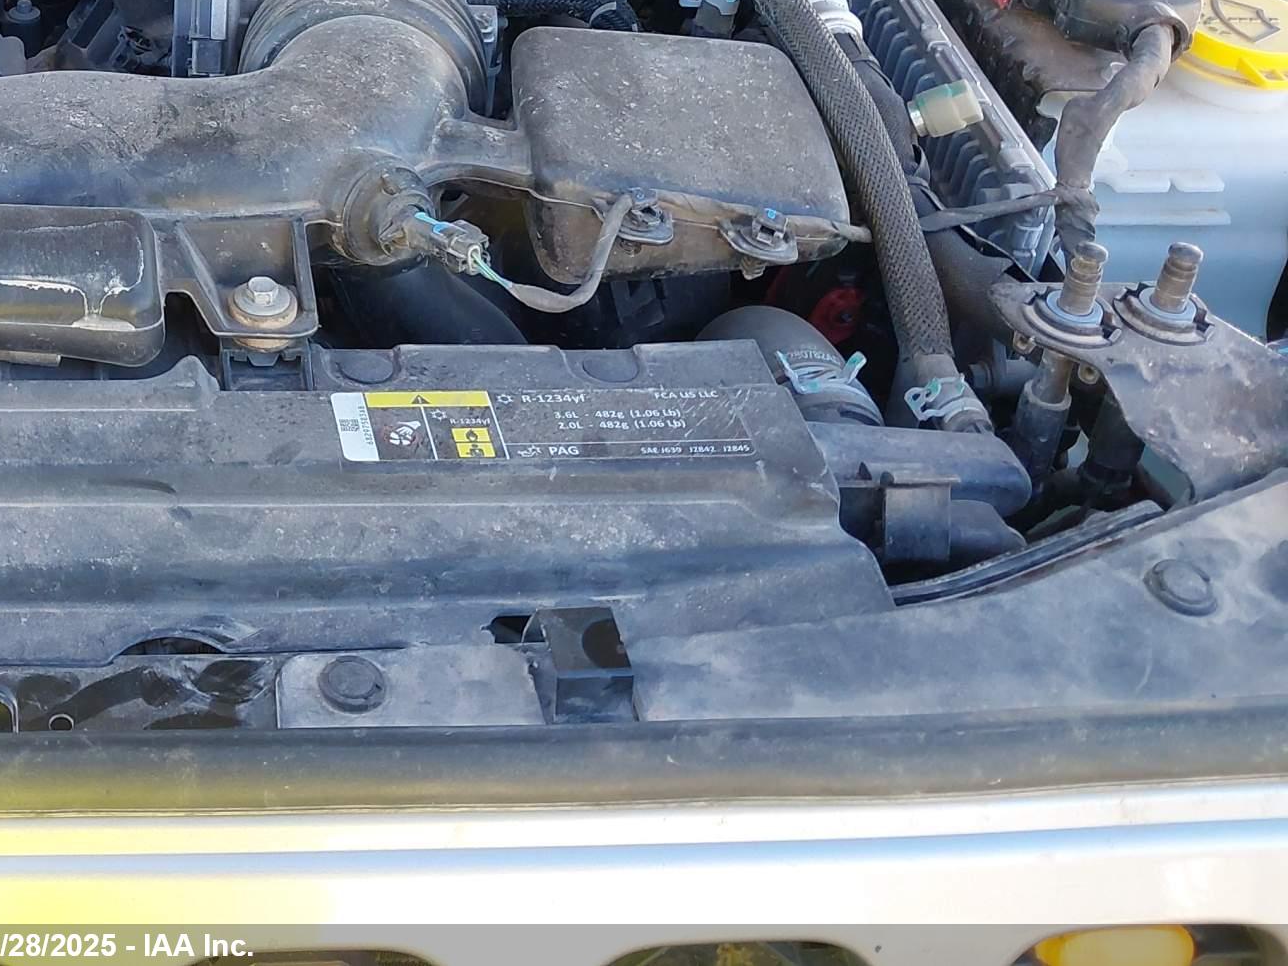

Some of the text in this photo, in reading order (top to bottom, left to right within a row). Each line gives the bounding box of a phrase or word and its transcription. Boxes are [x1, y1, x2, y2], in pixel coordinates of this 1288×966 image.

[521, 393, 587, 404] R-1234yf
[654, 390, 719, 399] FCA US LLC
[553, 411, 580, 419] 3.6L
[595, 410, 625, 420] 482g
[629, 409, 660, 419] (1.06
[558, 421, 584, 430] 2.0L
[599, 421, 630, 430] 482g
[634, 420, 665, 429] (1.06
[548, 446, 580, 456] PAG
